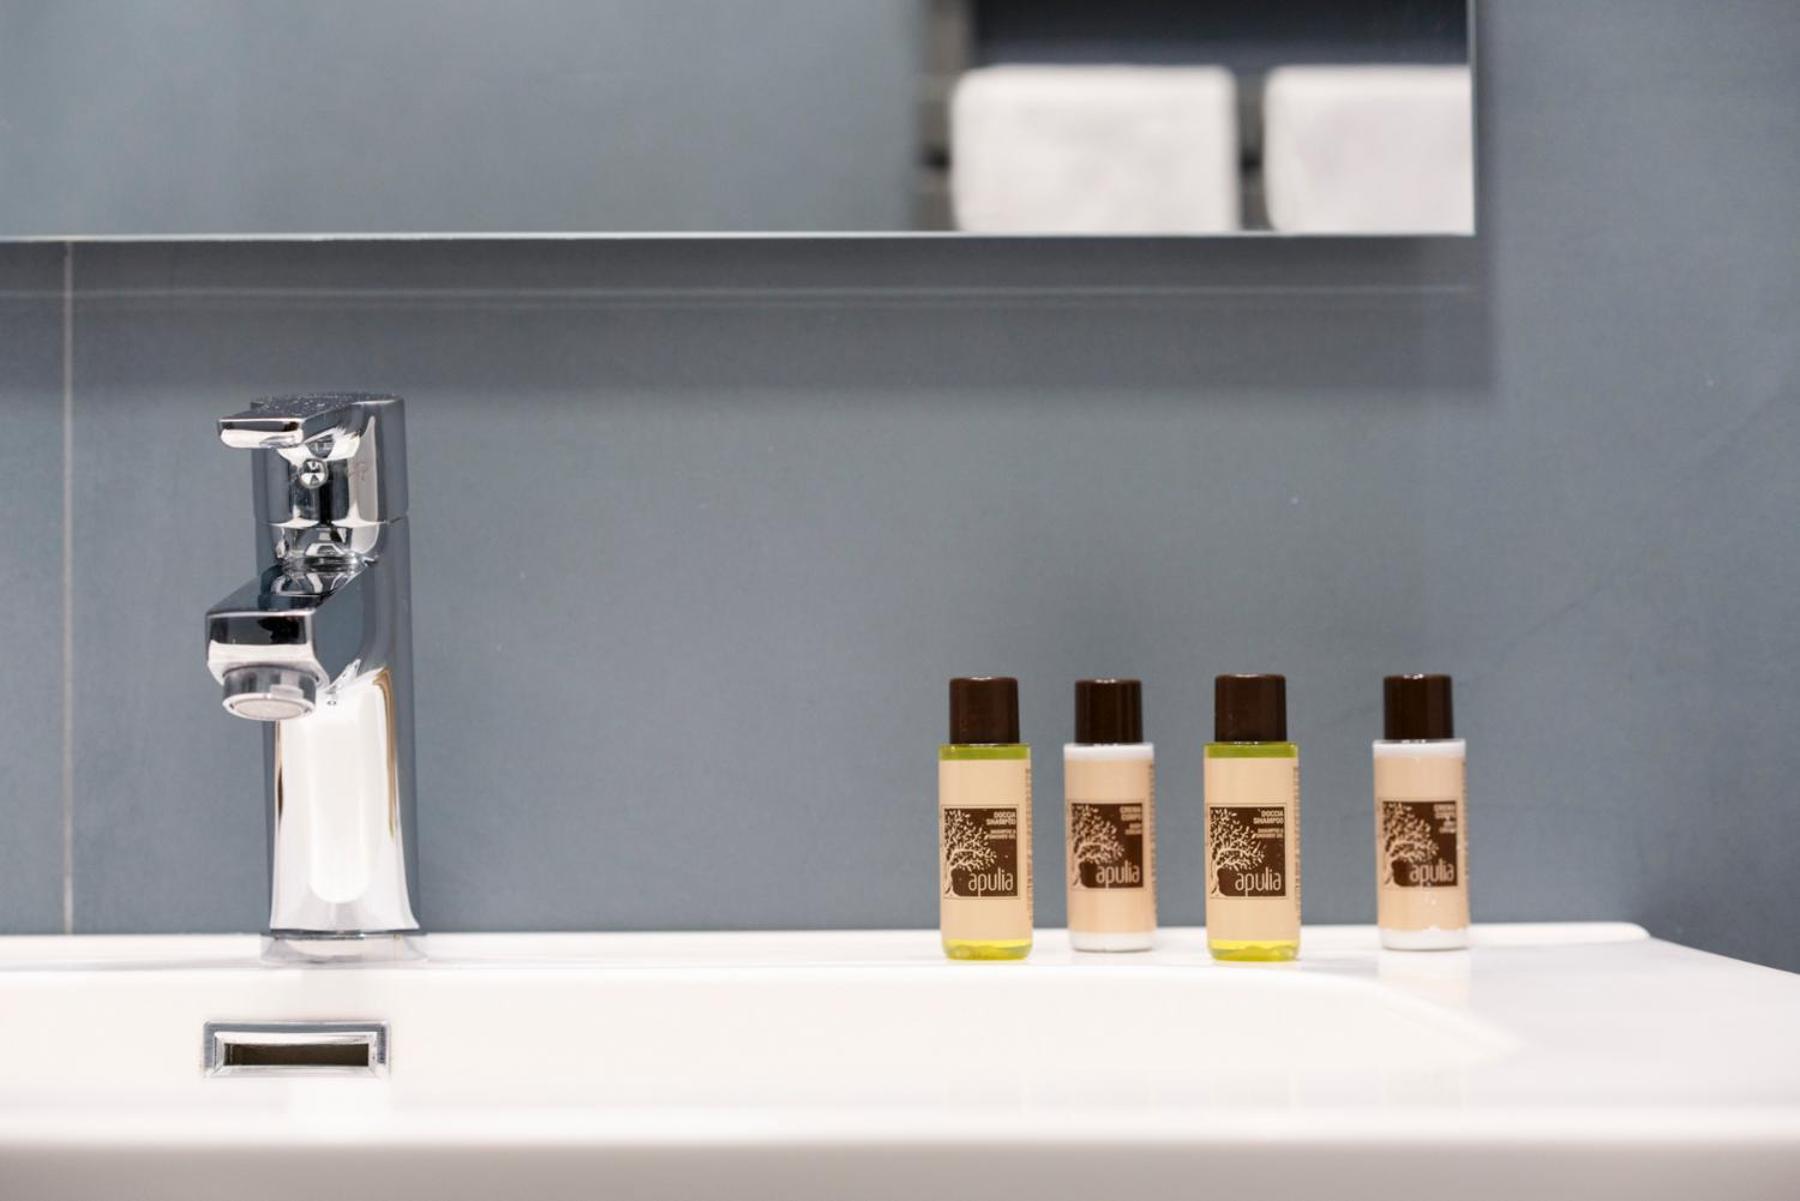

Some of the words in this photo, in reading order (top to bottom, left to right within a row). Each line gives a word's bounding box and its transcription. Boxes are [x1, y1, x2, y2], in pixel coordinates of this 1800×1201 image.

[1253, 817, 1284, 825] SHAMPOO
[967, 867, 1013, 897] apulia
[1095, 860, 1140, 889] apulia
[1235, 866, 1281, 897] apulia
[1409, 858, 1454, 887] apulia
